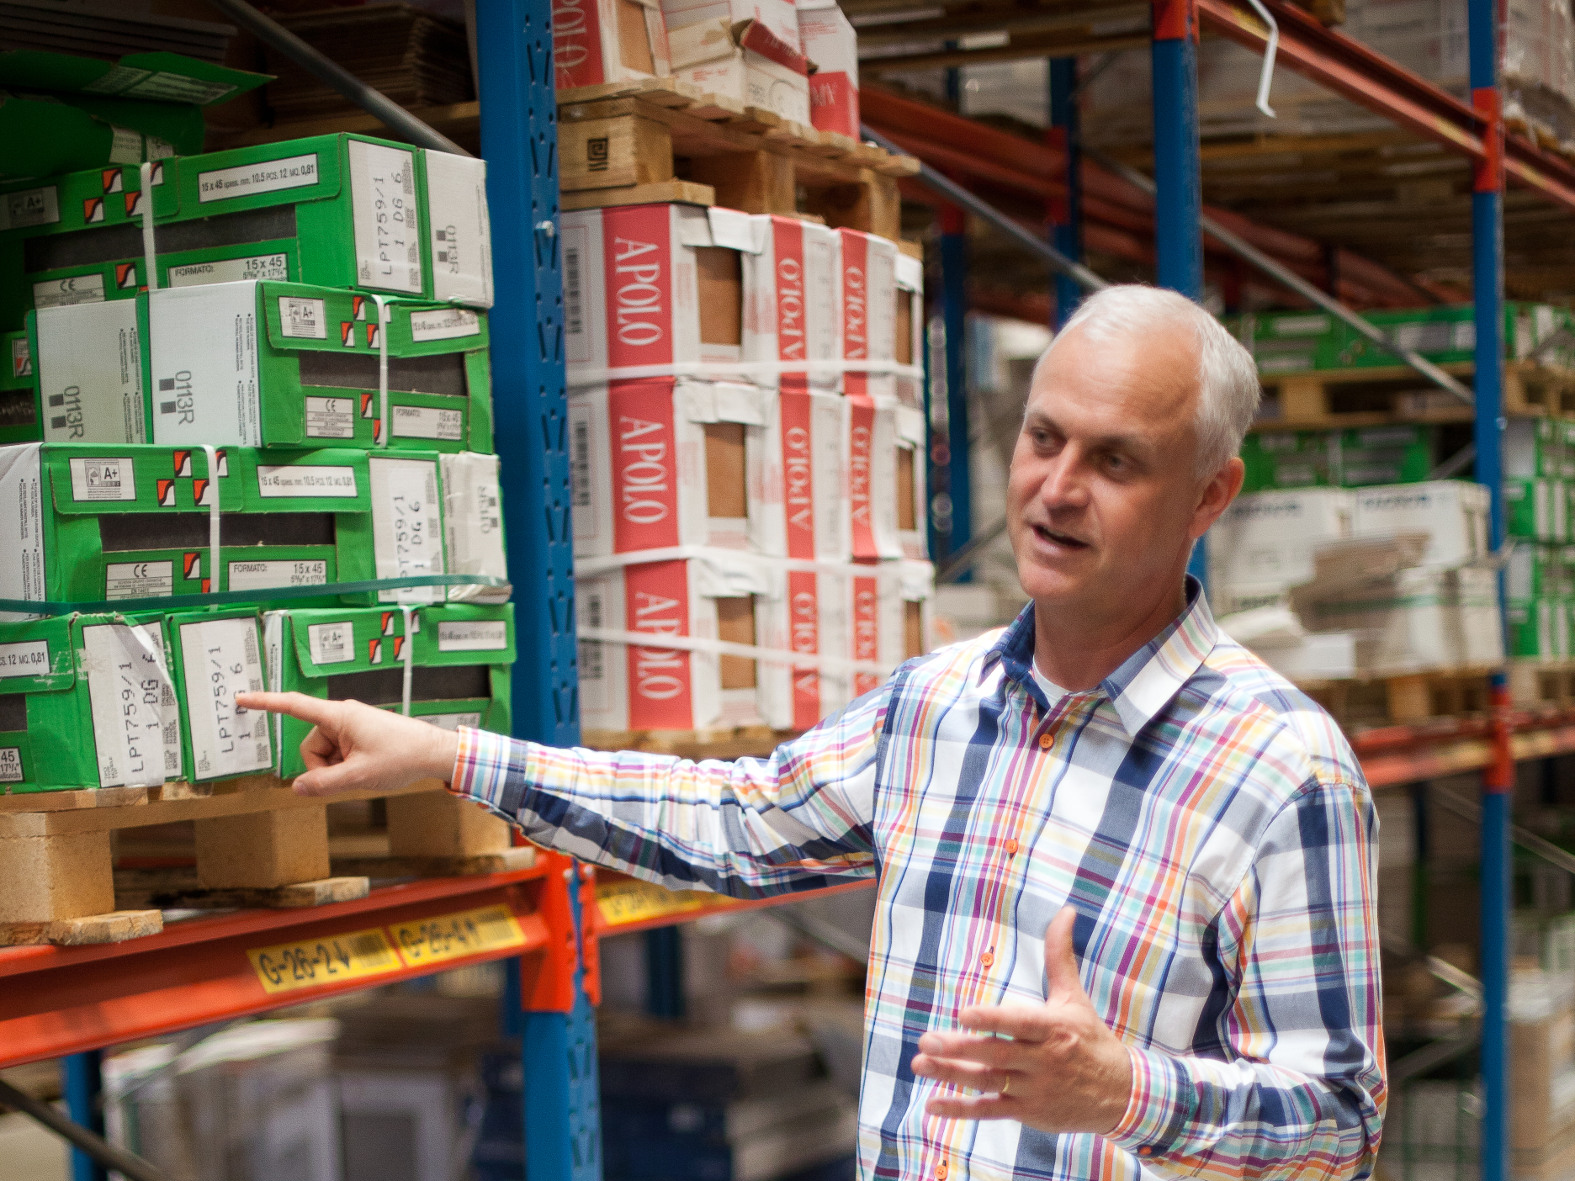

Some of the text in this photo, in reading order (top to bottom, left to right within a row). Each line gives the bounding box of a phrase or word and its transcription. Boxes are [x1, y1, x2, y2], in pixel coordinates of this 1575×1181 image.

[280, 168, 288, 179] 12
[246, 259, 258, 270] 15
[269, 256, 282, 268] 45
[373, 177, 392, 276] LPT759/1
[614, 236, 663, 346] APOLO
[778, 258, 805, 360] APOLO
[63, 385, 84, 440] 0113R
[175, 370, 195, 426] 0113R
[104, 466, 118, 480] A+
[619, 416, 669, 524] APOLO
[786, 427, 812, 531] APOLO
[852, 426, 871, 527] APOLO
[294, 563, 304, 574] 15
[8, 654, 16, 666] 12
[31, 652, 45, 666] 0,81
[230, 662, 243, 674] 6
[793, 591, 818, 697] AOLO
[118, 661, 144, 773] LPT759/1
[208, 646, 234, 754] LPT759/1
[1, 750, 15, 763] 45
